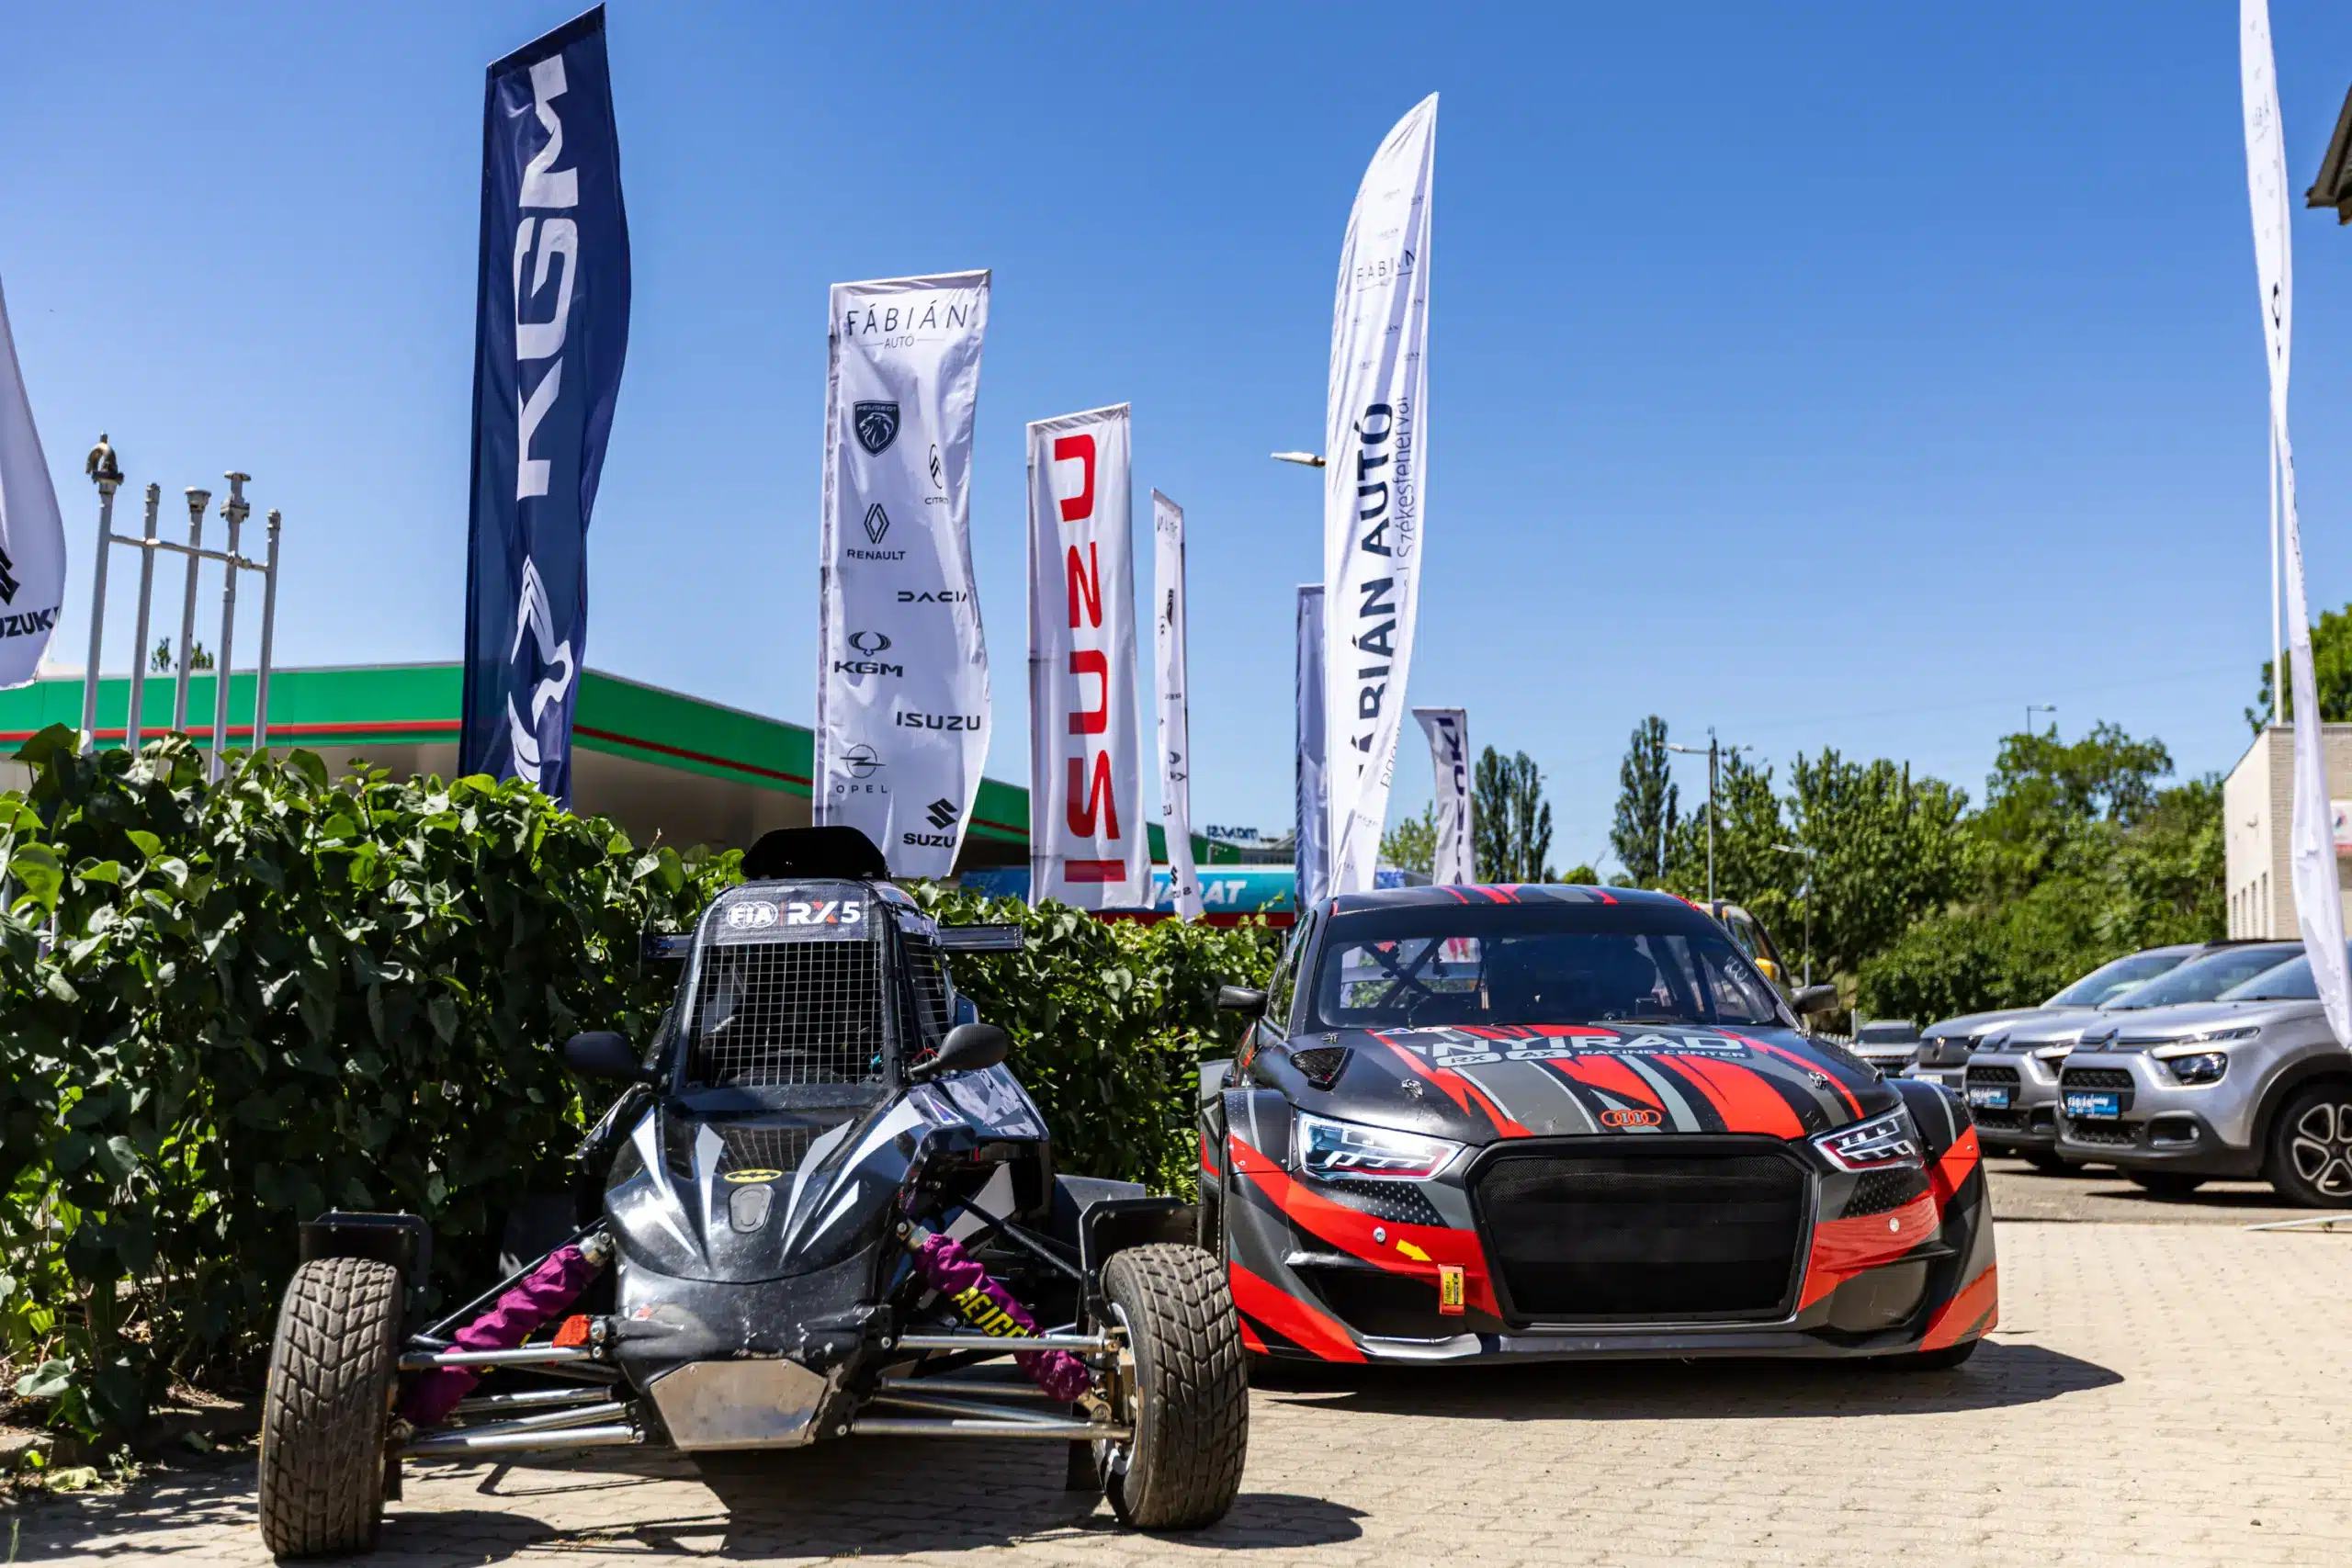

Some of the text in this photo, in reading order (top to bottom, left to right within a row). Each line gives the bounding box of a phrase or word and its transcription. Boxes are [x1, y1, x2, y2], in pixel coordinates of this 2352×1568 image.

[513, 52, 579, 502] KGM
[846, 299, 968, 336] FÁBIÁN
[1353, 402, 1394, 558] AUTÓ
[847, 548, 906, 561] RENAULT
[1055, 433, 1127, 883] ISUZU
[834, 661, 904, 678] KGM
[1351, 576, 1397, 778] ÁBIÁN
[896, 711, 981, 731] ISUZU
[836, 784, 888, 795] OPEL
[903, 832, 956, 848] SUZU
[1451, 1055, 1486, 1064] RX
[1519, 1048, 1556, 1057] AX
[1664, 1050, 1747, 1058] CENTER
